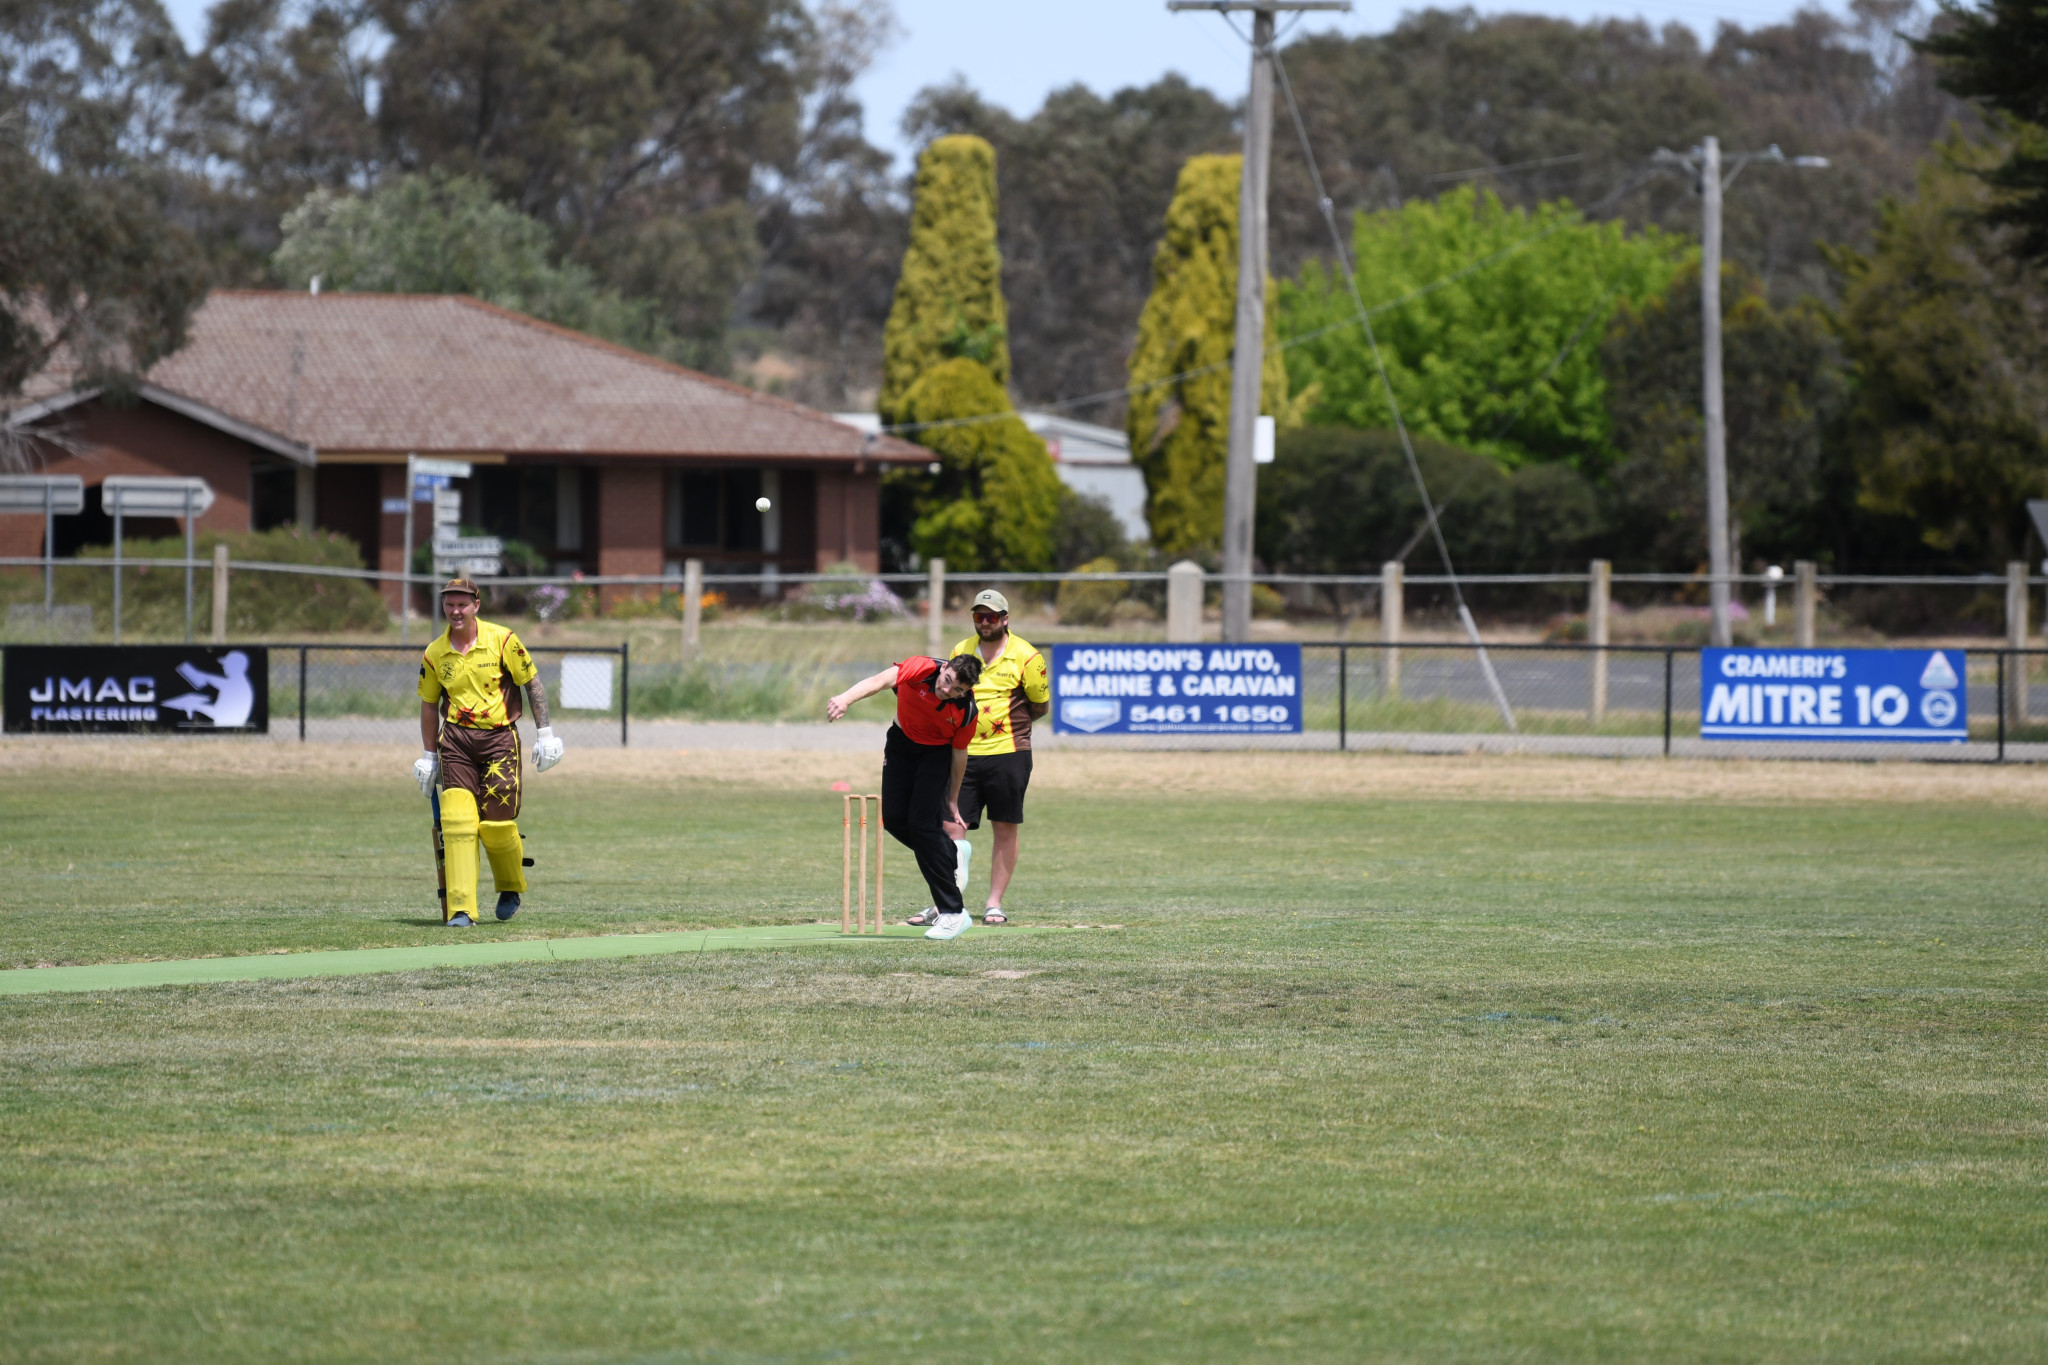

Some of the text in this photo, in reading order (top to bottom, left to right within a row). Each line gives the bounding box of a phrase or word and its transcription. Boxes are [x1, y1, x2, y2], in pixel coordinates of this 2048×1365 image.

[1065, 650, 1281, 675] JOHNSON'S AUTO,
[1720, 654, 1848, 678] CRAMERI'S
[29, 676, 156, 703] JMAC
[1058, 675, 1152, 697] MARINE
[1156, 675, 1177, 697] &
[1181, 675, 1296, 697] CARAVAN
[30, 705, 159, 722] PLASTERING
[1129, 704, 1290, 723] 5461 1650
[1705, 683, 1909, 726] MITRE 10
